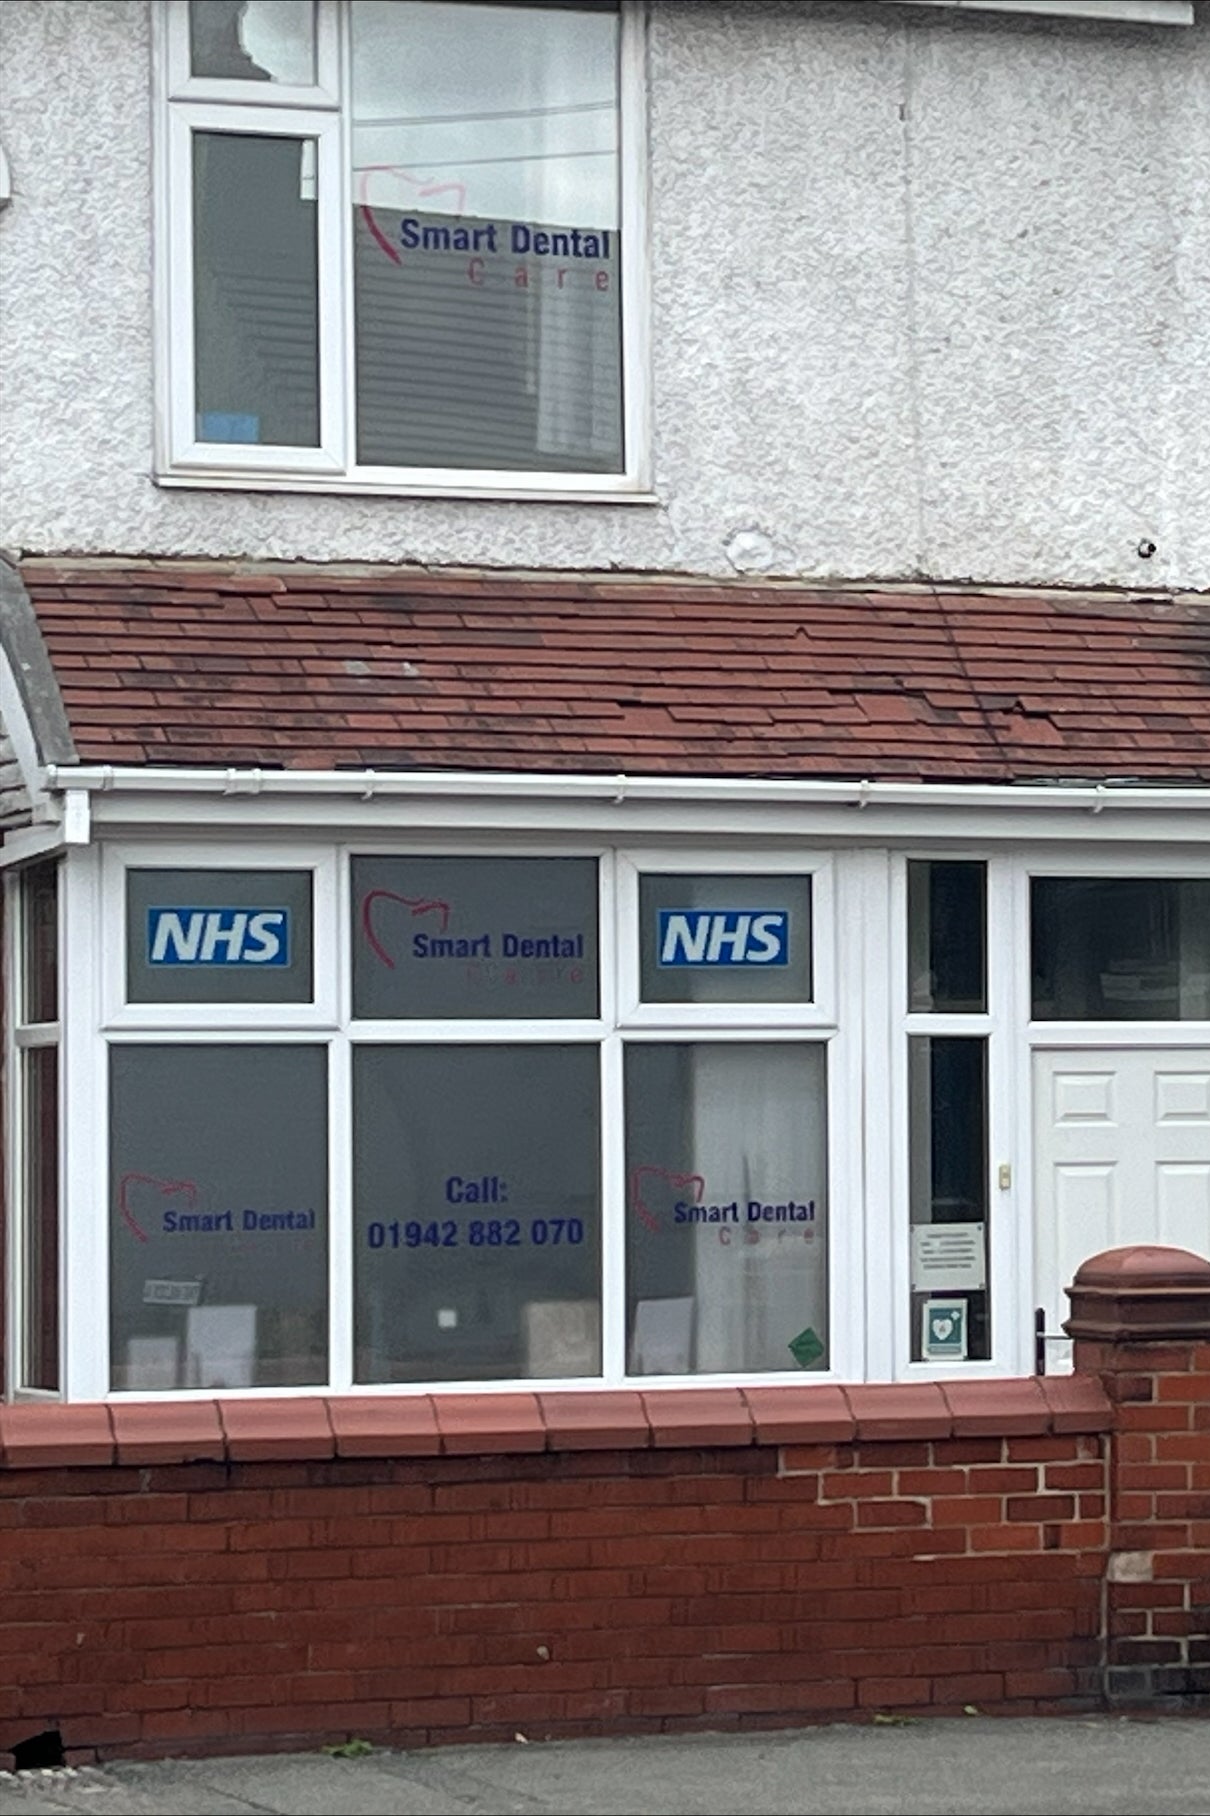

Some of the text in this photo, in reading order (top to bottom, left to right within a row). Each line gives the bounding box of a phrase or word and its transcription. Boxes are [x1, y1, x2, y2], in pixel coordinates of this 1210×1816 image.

[400, 219, 610, 259] Smart Dental
[152, 912, 284, 962] NHS
[413, 933, 584, 958] Smart Dental
[662, 914, 784, 962] NHS
[446, 1176, 508, 1203] Call:
[163, 1208, 315, 1232] Smart Dental
[674, 1201, 815, 1223] Smart Dental
[368, 1218, 584, 1249] 01942 882 070
